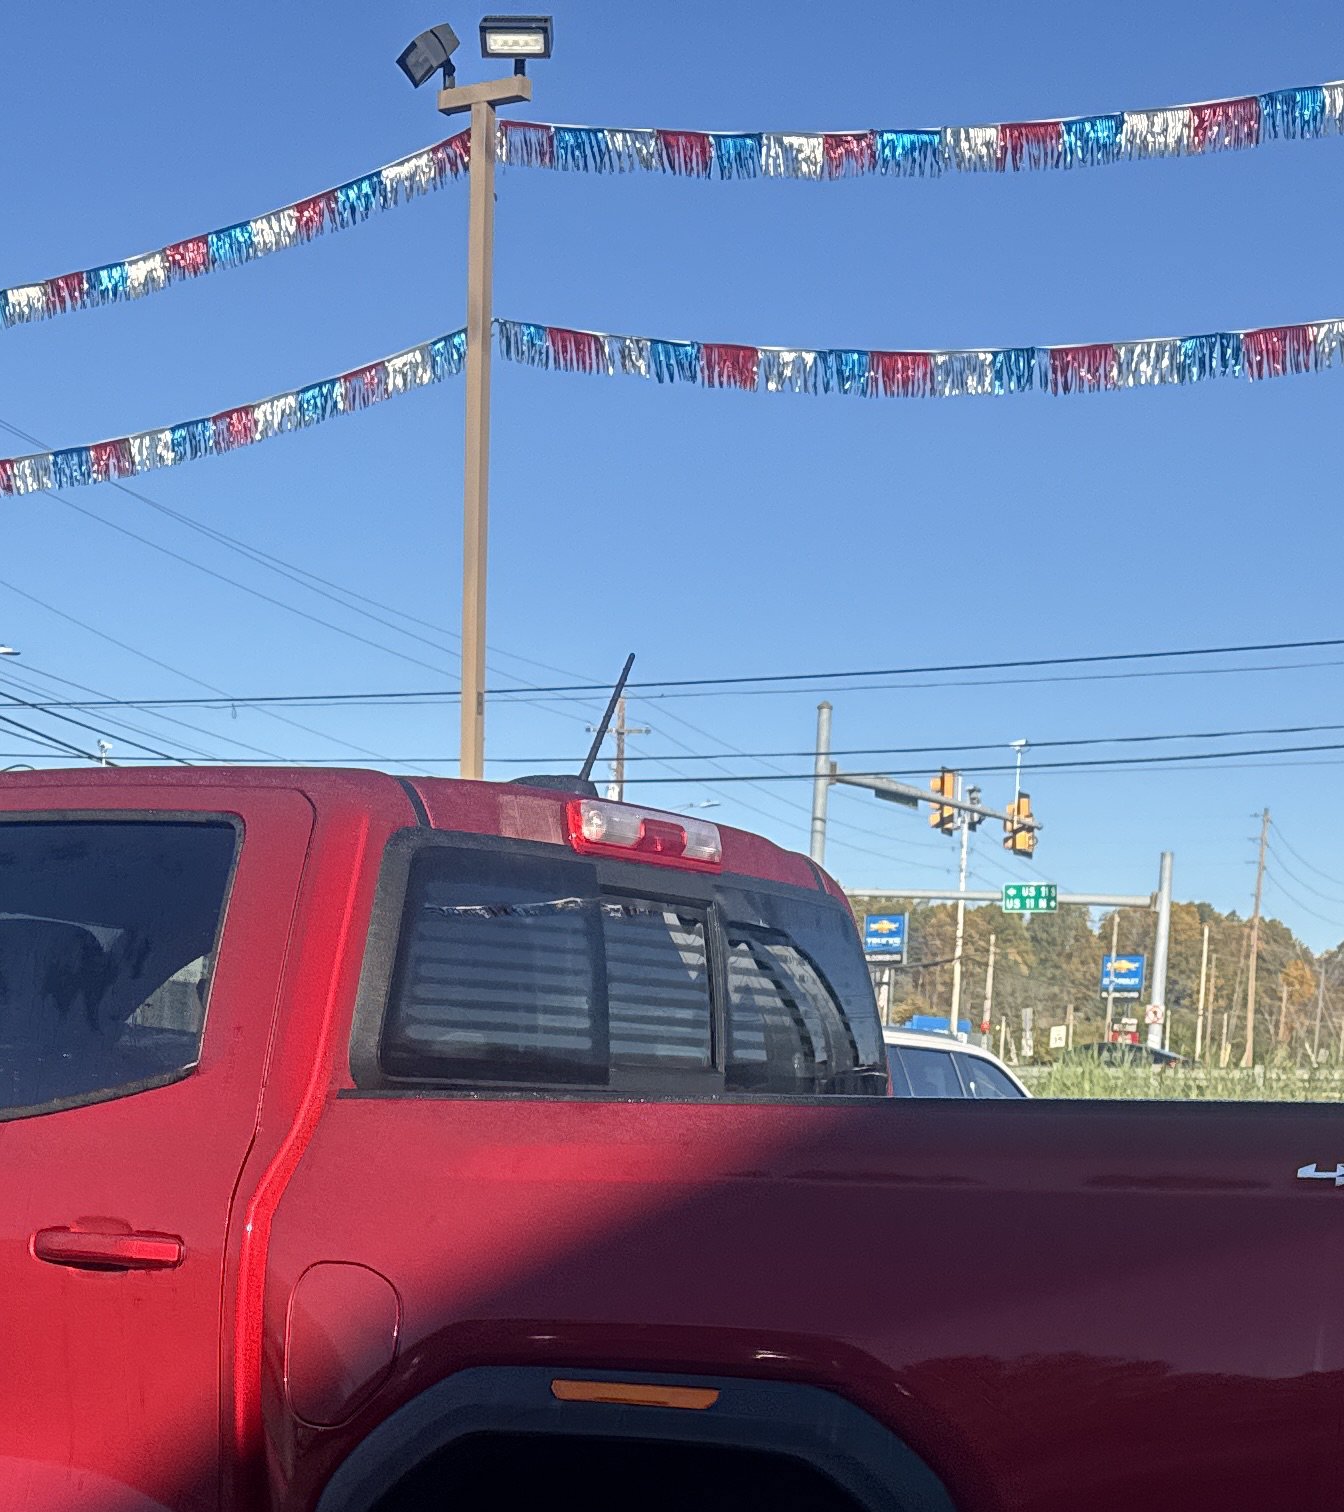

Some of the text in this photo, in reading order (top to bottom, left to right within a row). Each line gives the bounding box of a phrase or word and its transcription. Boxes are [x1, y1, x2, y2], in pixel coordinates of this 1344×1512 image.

[1021, 886, 1036, 897] US
[1006, 898, 1021, 909] US
[1025, 898, 1035, 909] 11
